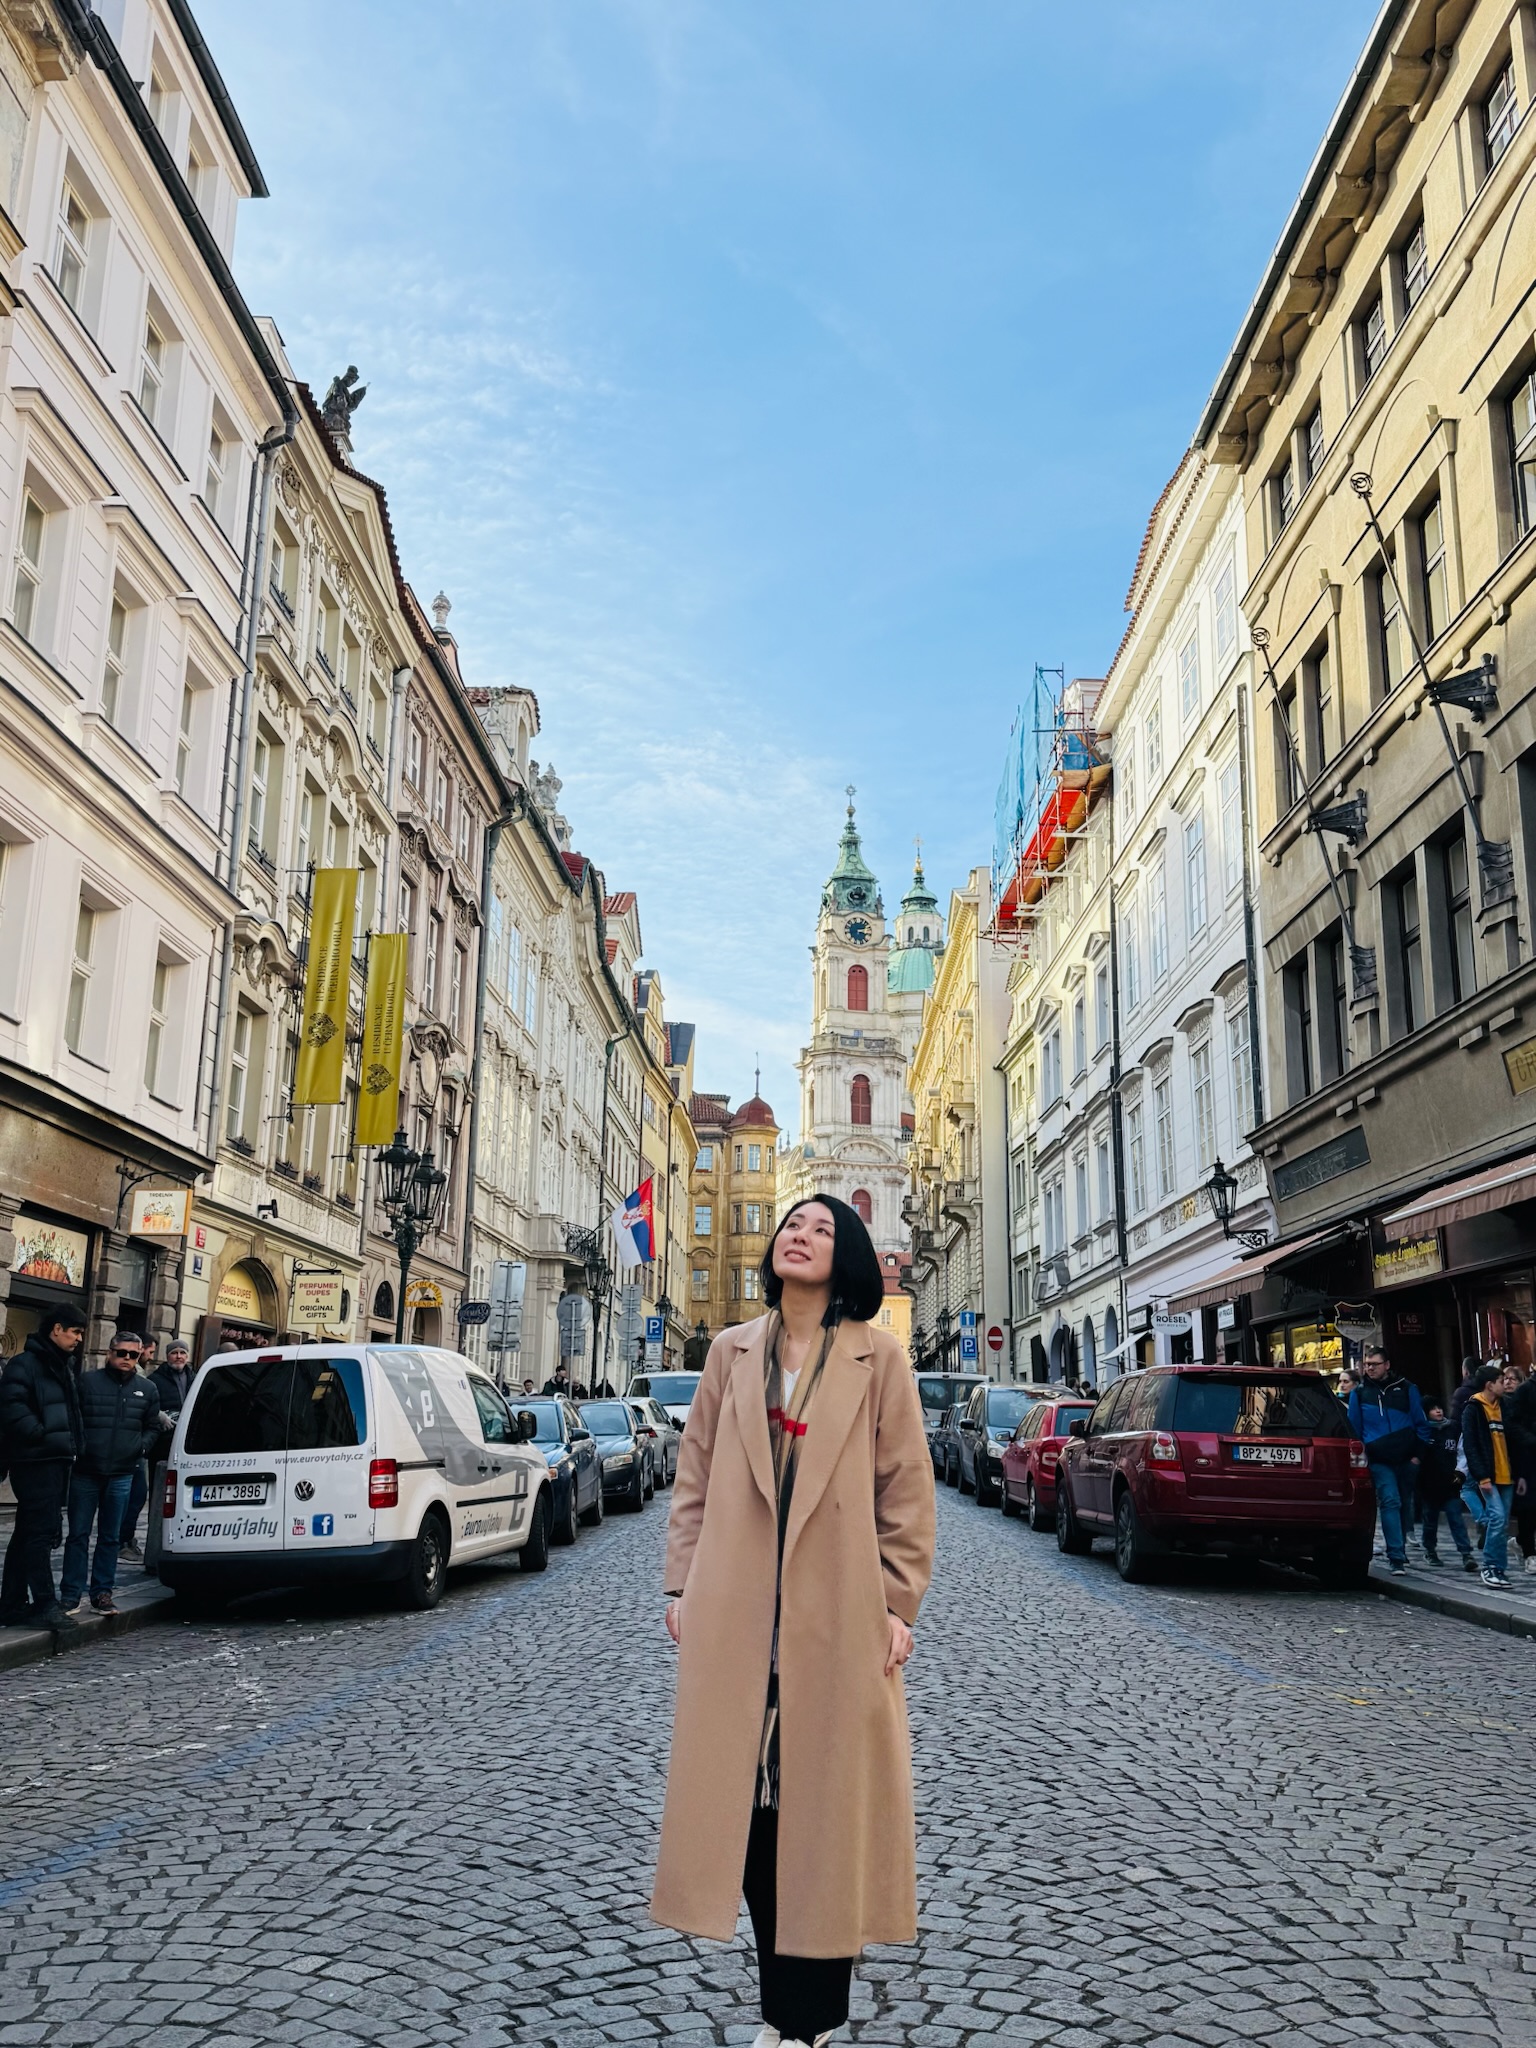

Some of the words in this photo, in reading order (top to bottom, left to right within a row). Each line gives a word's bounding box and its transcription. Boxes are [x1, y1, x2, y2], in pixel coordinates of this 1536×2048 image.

[331, 920, 343, 947] ORLA
[315, 945, 328, 1002] RESIDENCE
[386, 980, 396, 1006] ORLA
[372, 1003, 383, 1054] RESIDENCE
[650, 1319, 660, 1334] P
[1156, 1315, 1187, 1324] ROESEL
[964, 1339, 974, 1353] P
[274, 1452, 364, 1465] www.eurovytahy.cz
[1242, 1447, 1262, 1459] 8P2
[1270, 1447, 1296, 1460] 4976
[194, 1460, 211, 1468] +420
[211, 1460, 226, 1468] 737
[227, 1459, 240, 1467] 211
[242, 1458, 257, 1466] 301
[203, 1486, 225, 1500] 4AT
[232, 1484, 261, 1499] 3896
[185, 1516, 279, 1540] eurovýtahy
[293, 1517, 305, 1525] You
[321, 1515, 331, 1534] f
